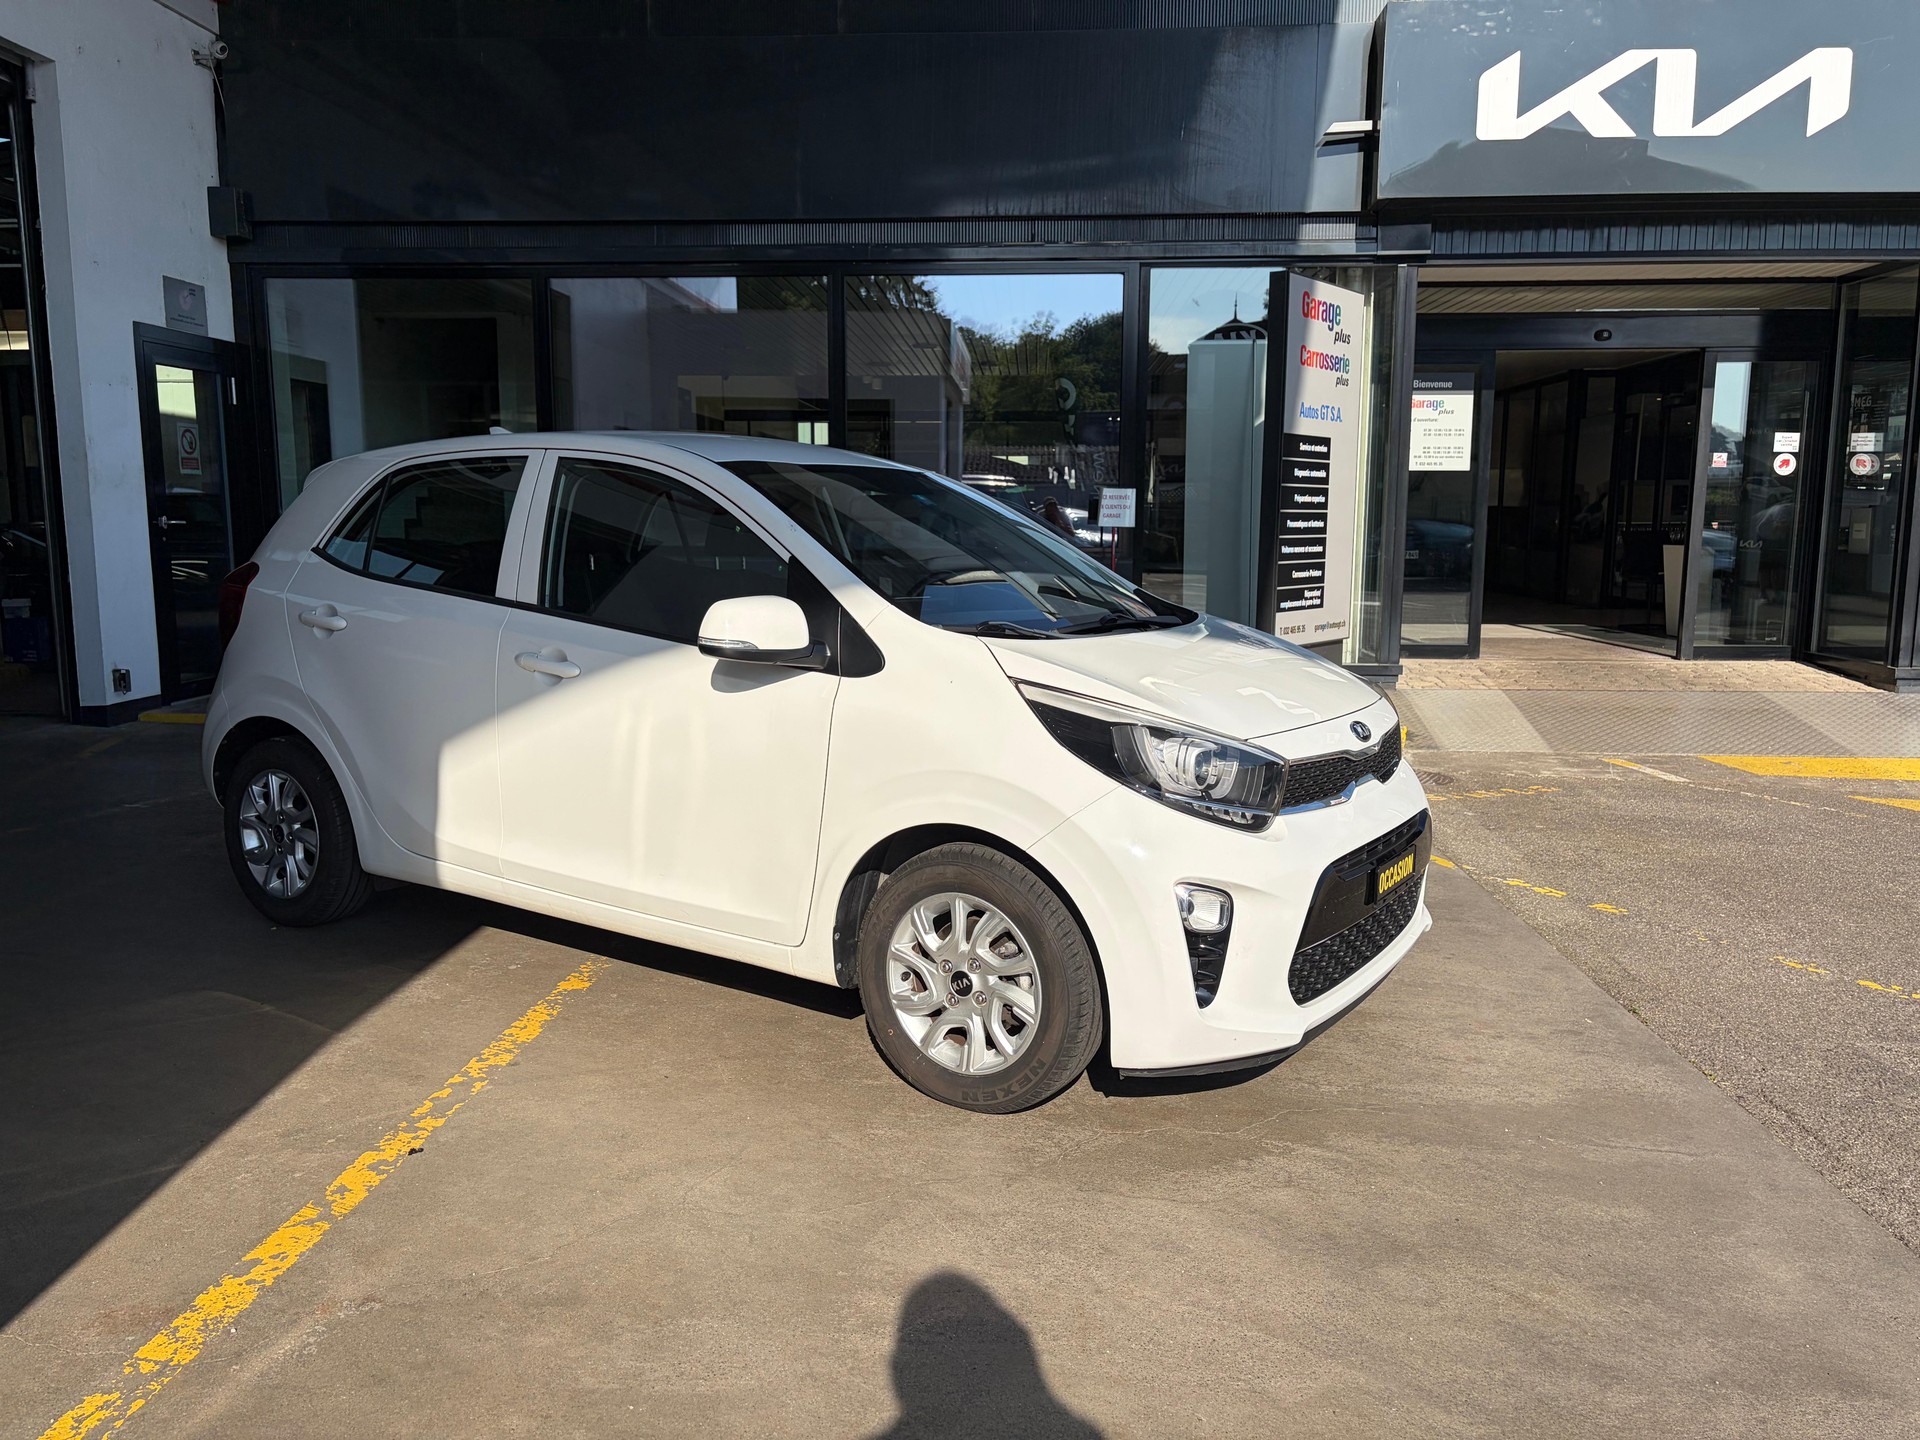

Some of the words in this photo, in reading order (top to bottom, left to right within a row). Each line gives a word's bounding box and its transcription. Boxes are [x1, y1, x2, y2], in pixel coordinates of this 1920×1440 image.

[1476, 47, 1853, 140] KIA
[1302, 291, 1341, 332] Garage
[1334, 329, 1351, 345] plus
[1300, 345, 1350, 375] Carrosserie
[1335, 375, 1349, 387] plus
[1413, 379, 1453, 388] Bienvenue
[1300, 402, 1319, 420] Autos
[1320, 404, 1329, 421] GT
[1438, 408, 1455, 416] plus
[1379, 853, 1413, 894] OCCASION
[952, 977, 971, 991] KIA
[961, 1056, 1048, 1103] NEXEN
